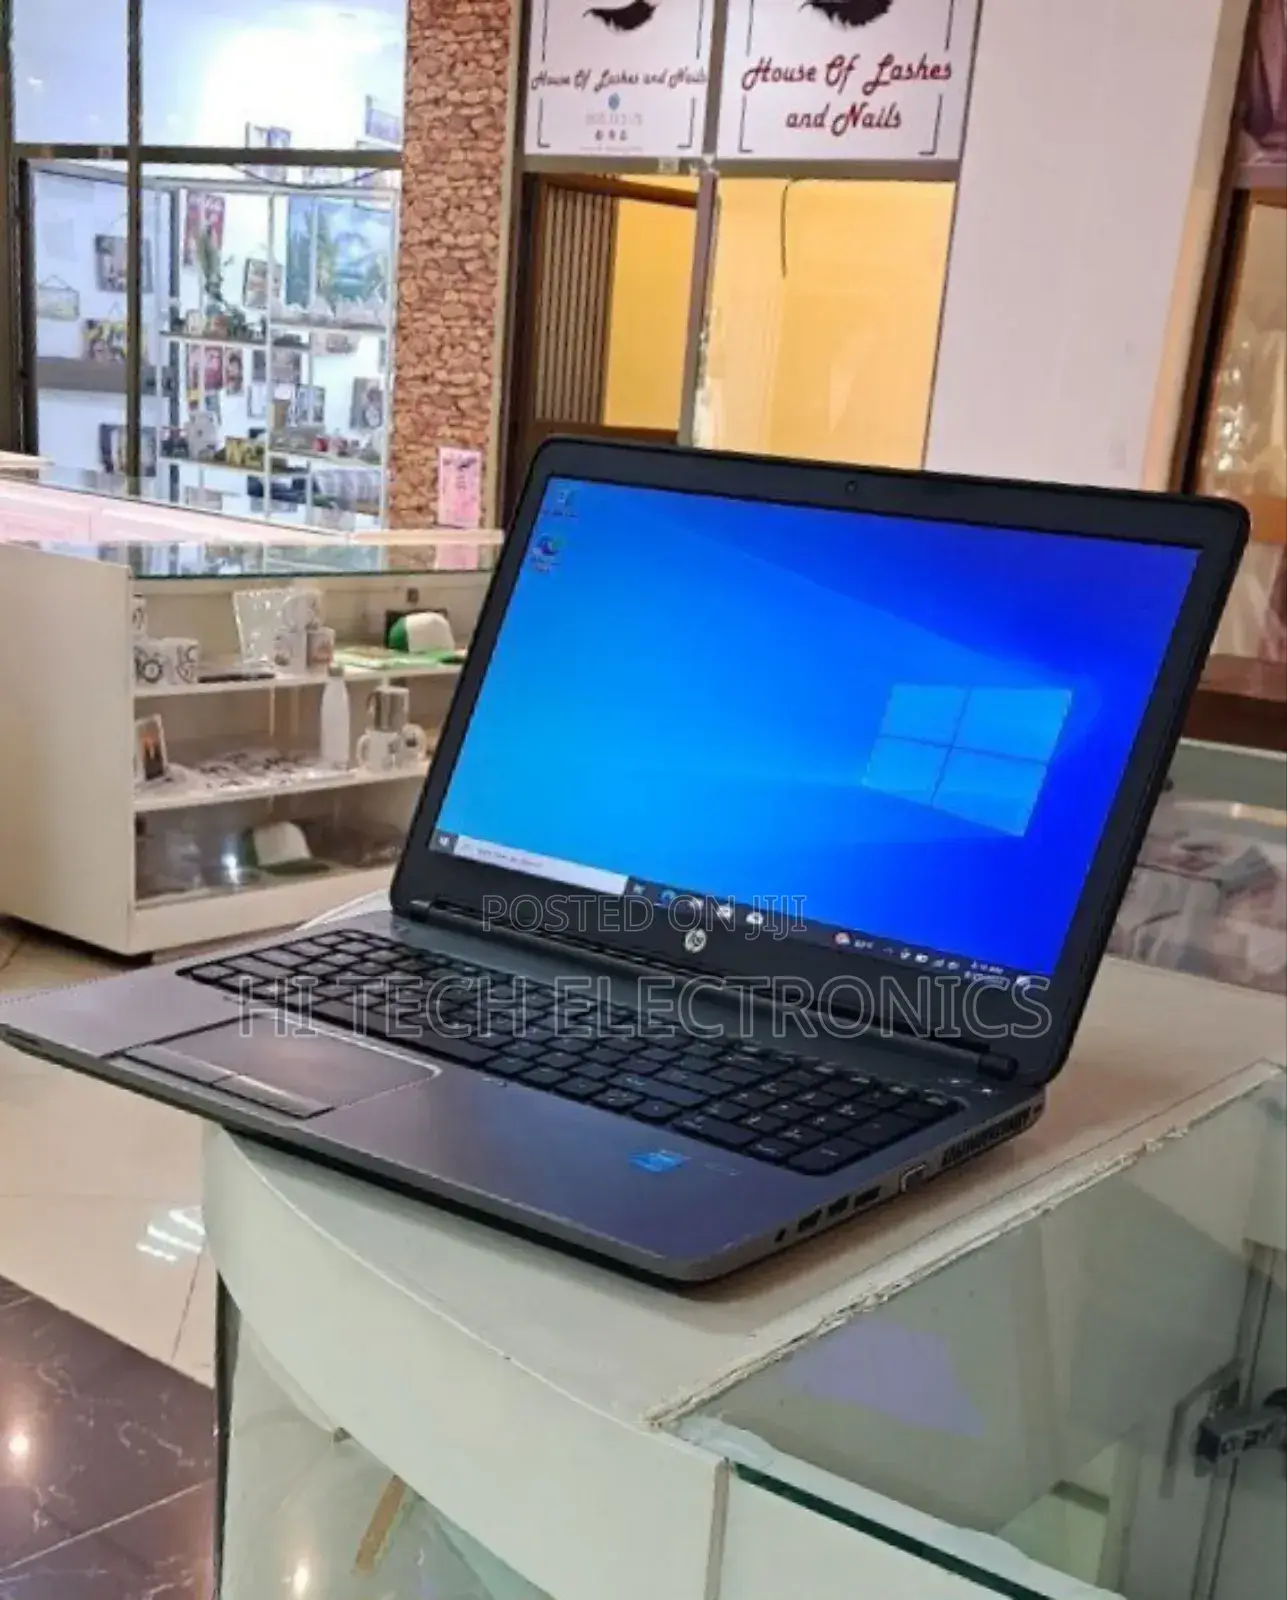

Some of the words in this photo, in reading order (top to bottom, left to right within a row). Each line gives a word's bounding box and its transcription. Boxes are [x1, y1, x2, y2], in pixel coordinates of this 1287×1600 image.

[742, 56, 817, 91] House
[825, 54, 860, 95] Of
[862, 53, 952, 96] Lashes
[786, 103, 830, 128] and
[831, 101, 902, 137] Nails
